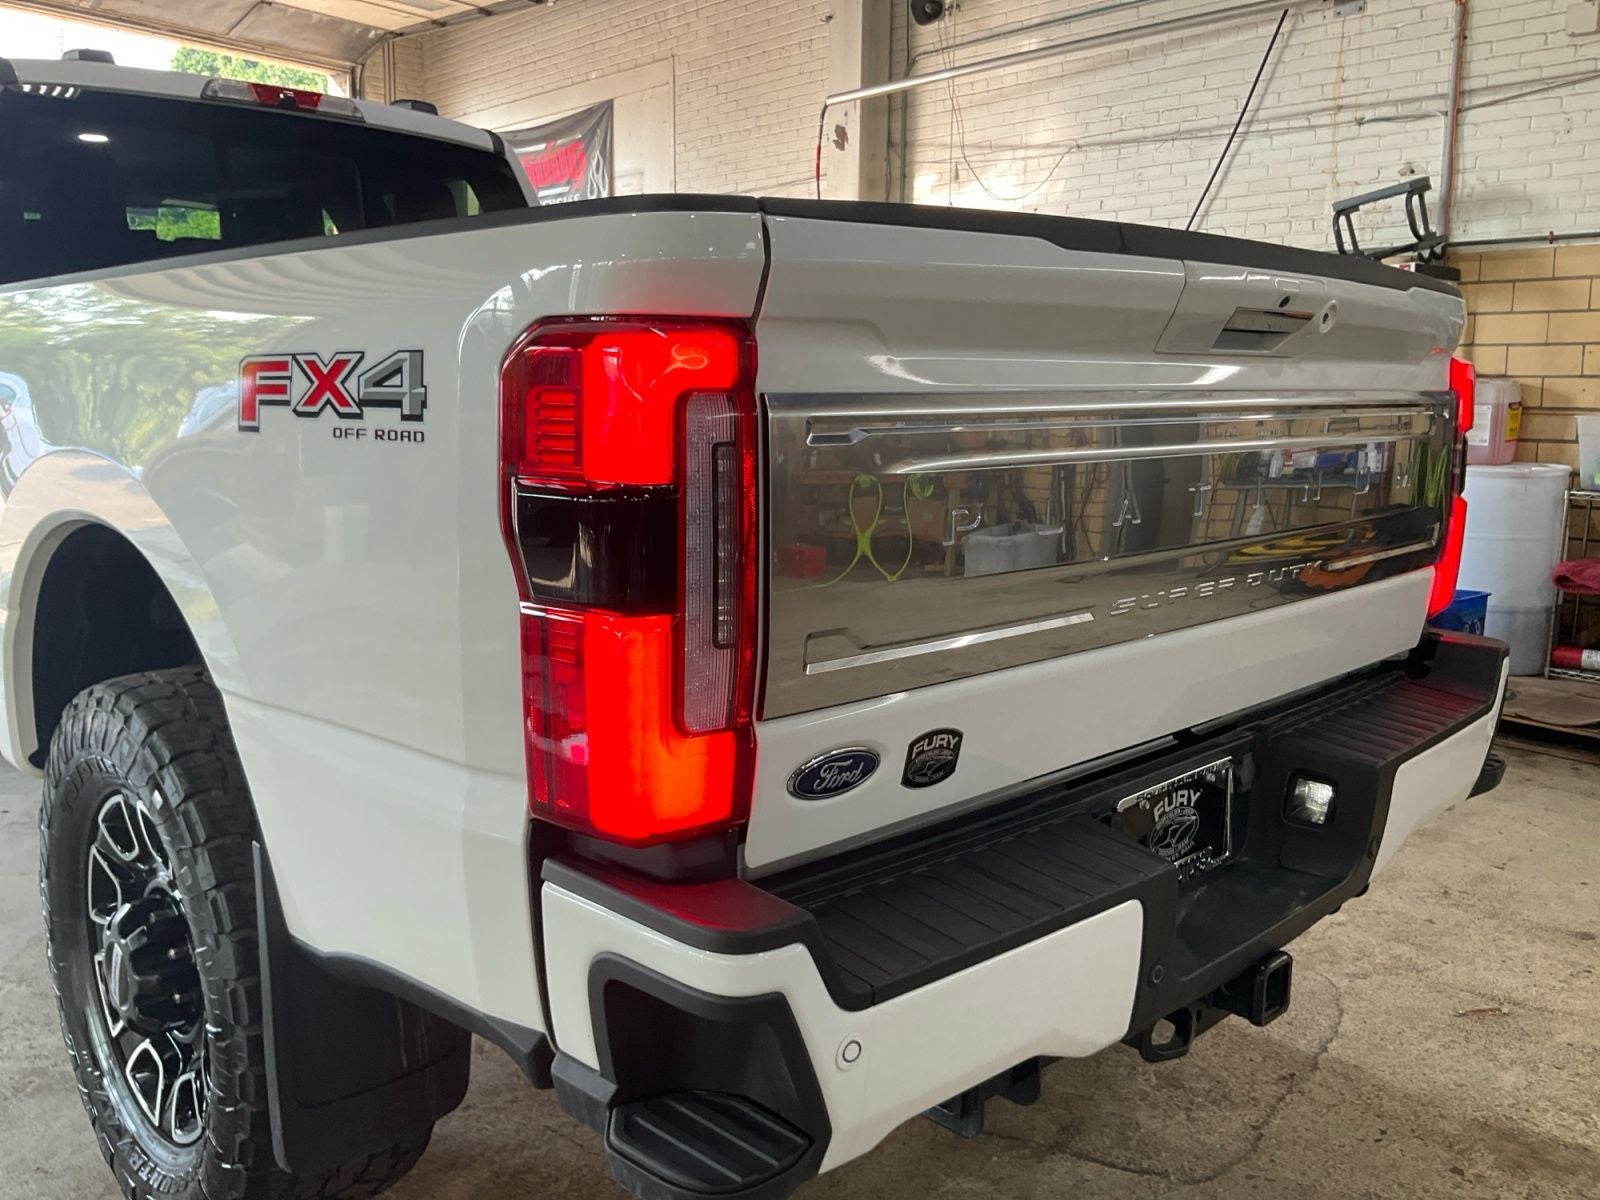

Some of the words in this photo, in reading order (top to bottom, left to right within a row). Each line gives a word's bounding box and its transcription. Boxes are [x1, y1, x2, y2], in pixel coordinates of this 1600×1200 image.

[238, 349, 427, 432] FX4
[332, 427, 367, 440] OFF
[374, 428, 425, 443] ROAD
[1246, 560, 1323, 588] DUTY
[911, 734, 960, 760] FURY
[813, 758, 865, 792] Ford
[1152, 789, 1202, 822] FURY
